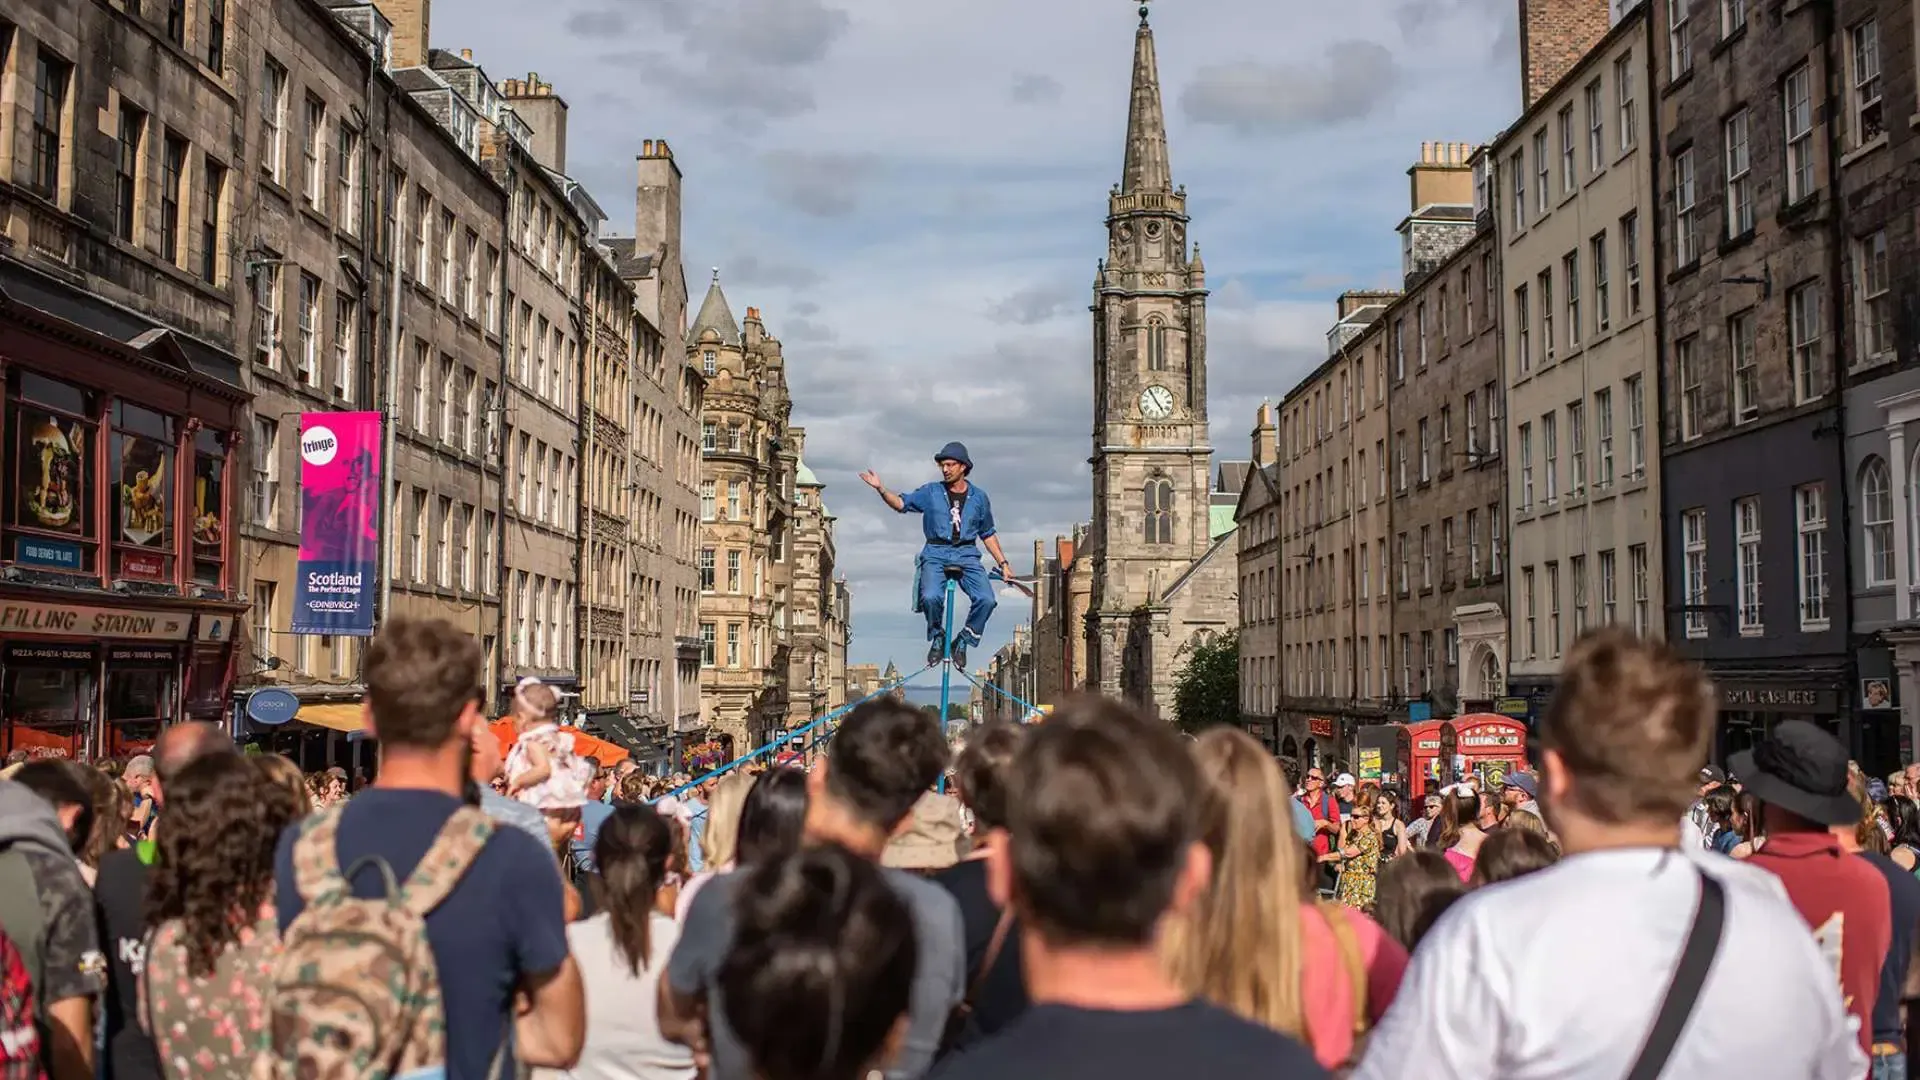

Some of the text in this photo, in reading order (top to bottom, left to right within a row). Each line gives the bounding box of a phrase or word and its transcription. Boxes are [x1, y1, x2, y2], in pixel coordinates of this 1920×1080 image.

[303, 437, 335, 454] fringe
[308, 571, 362, 586] Scotland
[343, 586, 361, 595] Stage
[1, 606, 78, 631] FILLING
[92, 612, 156, 633] STATION
[12, 649, 92, 660] PIZZA PASTA BURGERS
[1727, 689, 1817, 705] ROYAL CASHMERE
